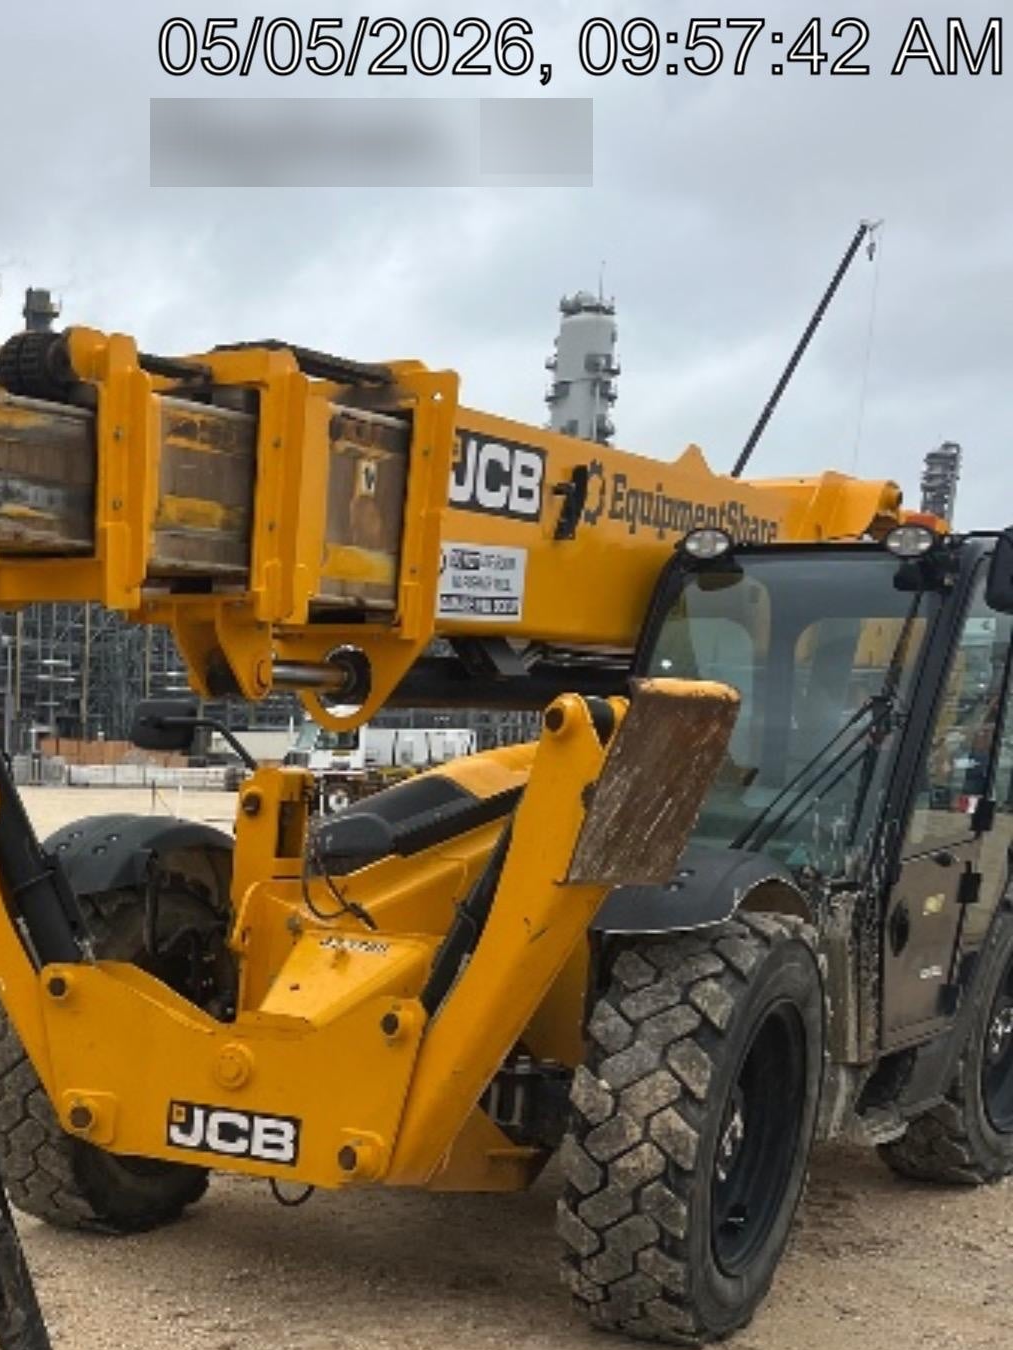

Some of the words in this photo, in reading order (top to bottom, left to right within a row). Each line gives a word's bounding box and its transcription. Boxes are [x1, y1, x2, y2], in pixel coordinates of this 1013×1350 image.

[449, 438, 543, 514] JCB
[609, 474, 777, 544] EquipmentShare
[169, 1106, 295, 1161] JCB
